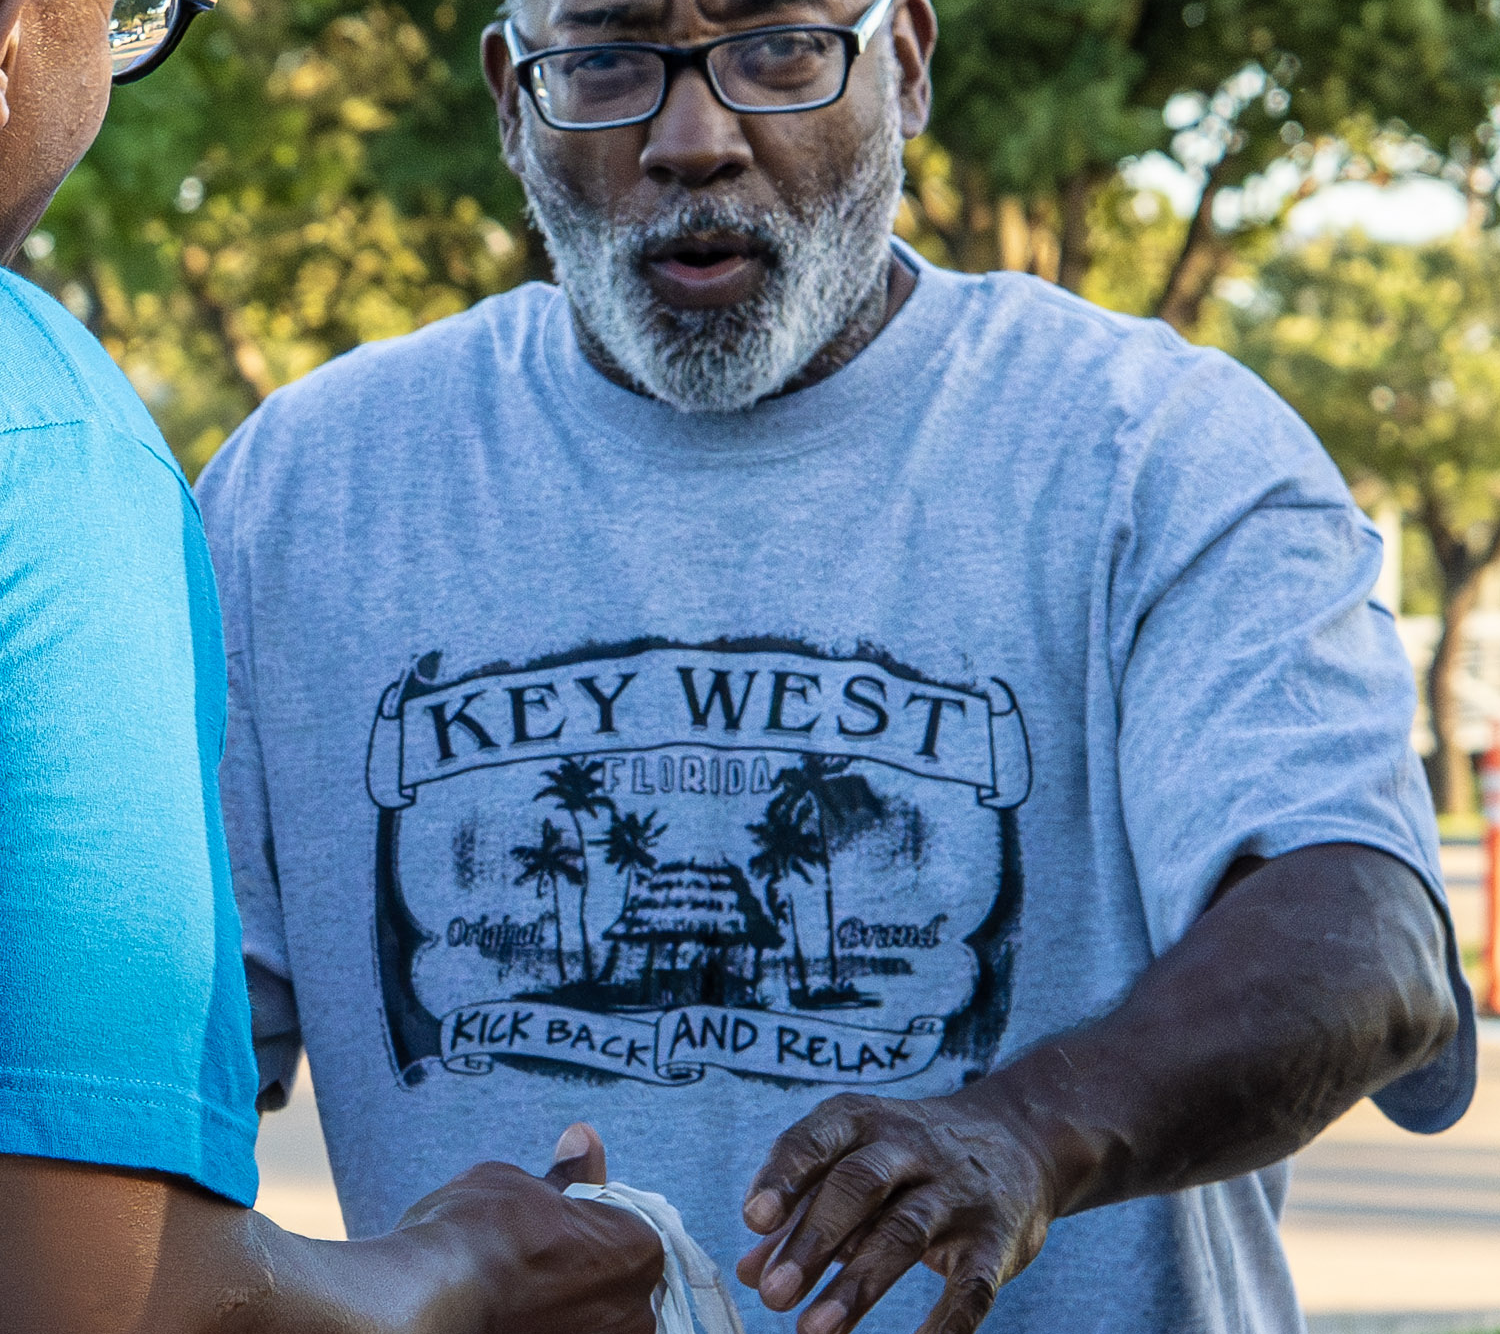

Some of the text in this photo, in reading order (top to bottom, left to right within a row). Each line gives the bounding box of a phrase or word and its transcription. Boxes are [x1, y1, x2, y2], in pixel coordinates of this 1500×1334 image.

[424, 666, 968, 763] KEY WEST
[602, 754, 771, 795] FLORIDA
[838, 913, 949, 949] Brand
[449, 1010, 911, 1073] KICK BACK AND RELAX
